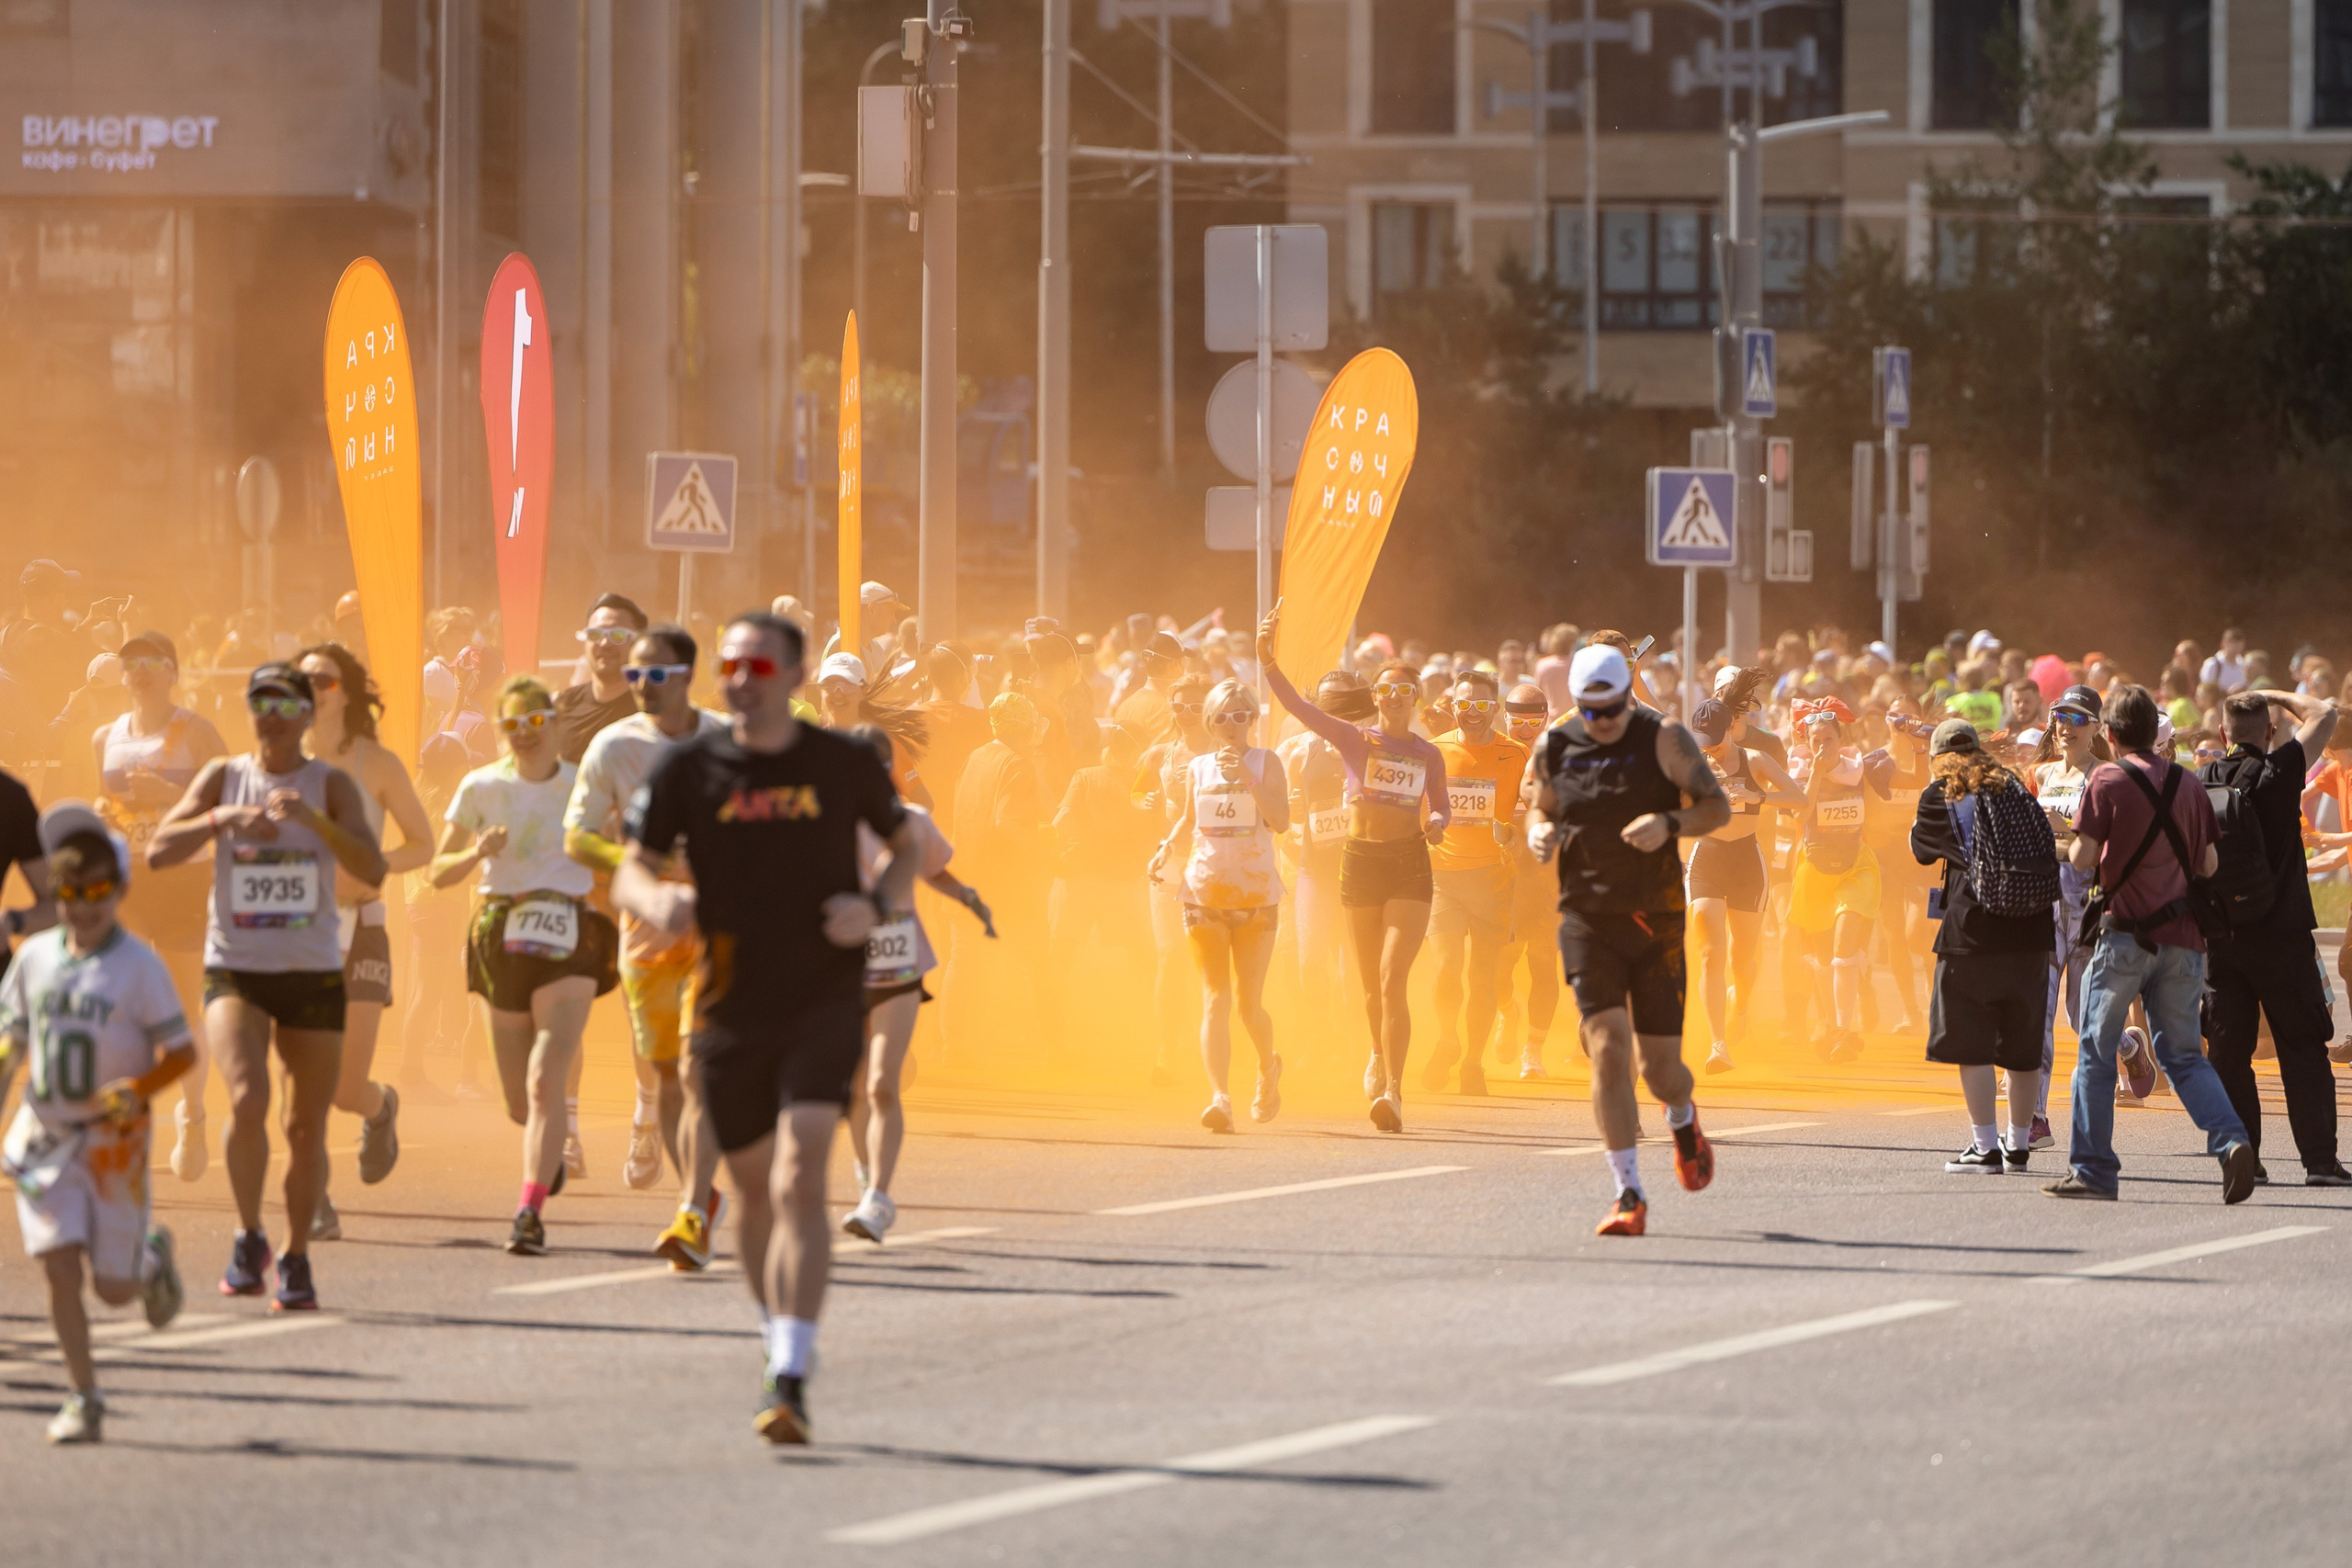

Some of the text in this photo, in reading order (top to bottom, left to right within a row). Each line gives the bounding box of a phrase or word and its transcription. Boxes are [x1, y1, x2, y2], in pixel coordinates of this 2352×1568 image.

[1330, 404, 1389, 436] КРА
[1326, 446, 1387, 479] СОЧ
[1322, 484, 1383, 517] НЫЙ
[1373, 766, 1414, 788] 4391
[1215, 802, 1237, 819] 46
[1449, 794, 1487, 811] 3218
[1824, 805, 1859, 821] 7255
[2050, 804, 2073, 820] 64
[243, 875, 306, 902] 3935
[516, 910, 568, 937] 7745
[866, 935, 909, 959] 802
